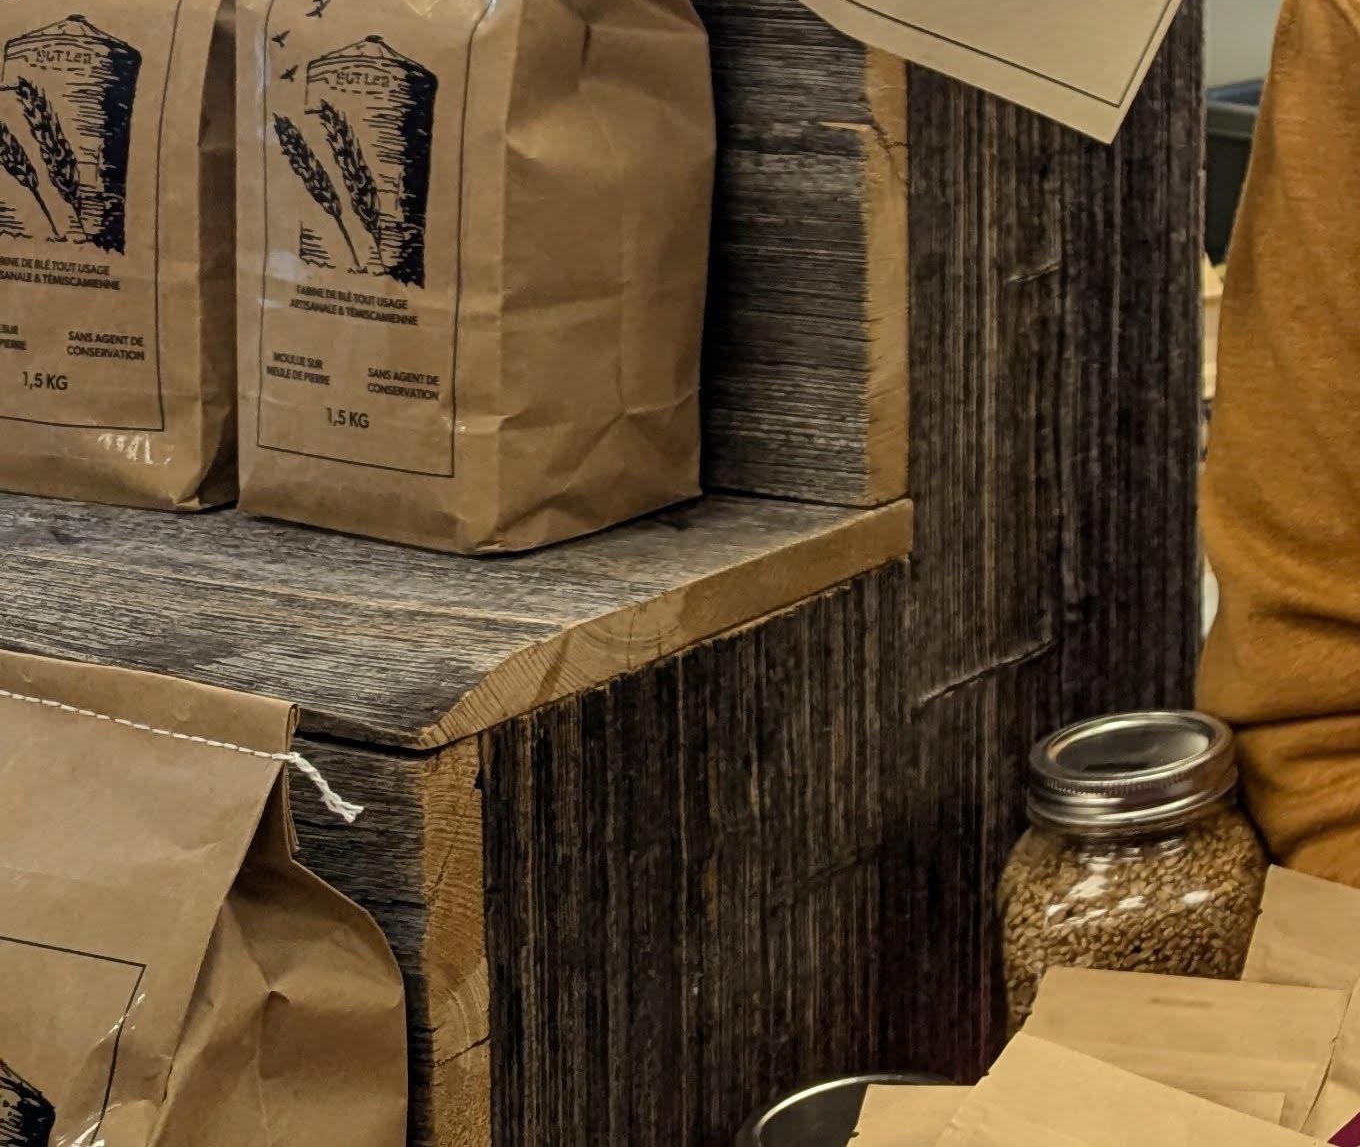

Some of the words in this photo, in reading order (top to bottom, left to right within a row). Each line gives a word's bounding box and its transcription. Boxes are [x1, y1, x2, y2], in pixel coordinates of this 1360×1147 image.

[21, 258, 32, 269] DE
[52, 262, 76, 273] TOUT
[78, 264, 110, 275] USAGE
[353, 293, 375, 306] TOUT
[377, 297, 408, 310] USAGE
[68, 331, 94, 343] SANS
[96, 334, 129, 346] AGENT
[130, 337, 143, 347] DE
[67, 346, 144, 361] CONSERVATION
[23, 371, 43, 390] 1,5
[46, 374, 68, 391] KG
[368, 368, 391, 381] SANS
[393, 371, 425, 385] AGENT
[426, 375, 440, 386] DE
[367, 383, 439, 401] CONSERVATION
[326, 407, 346, 427] 1,5
[350, 411, 369, 429] KG
